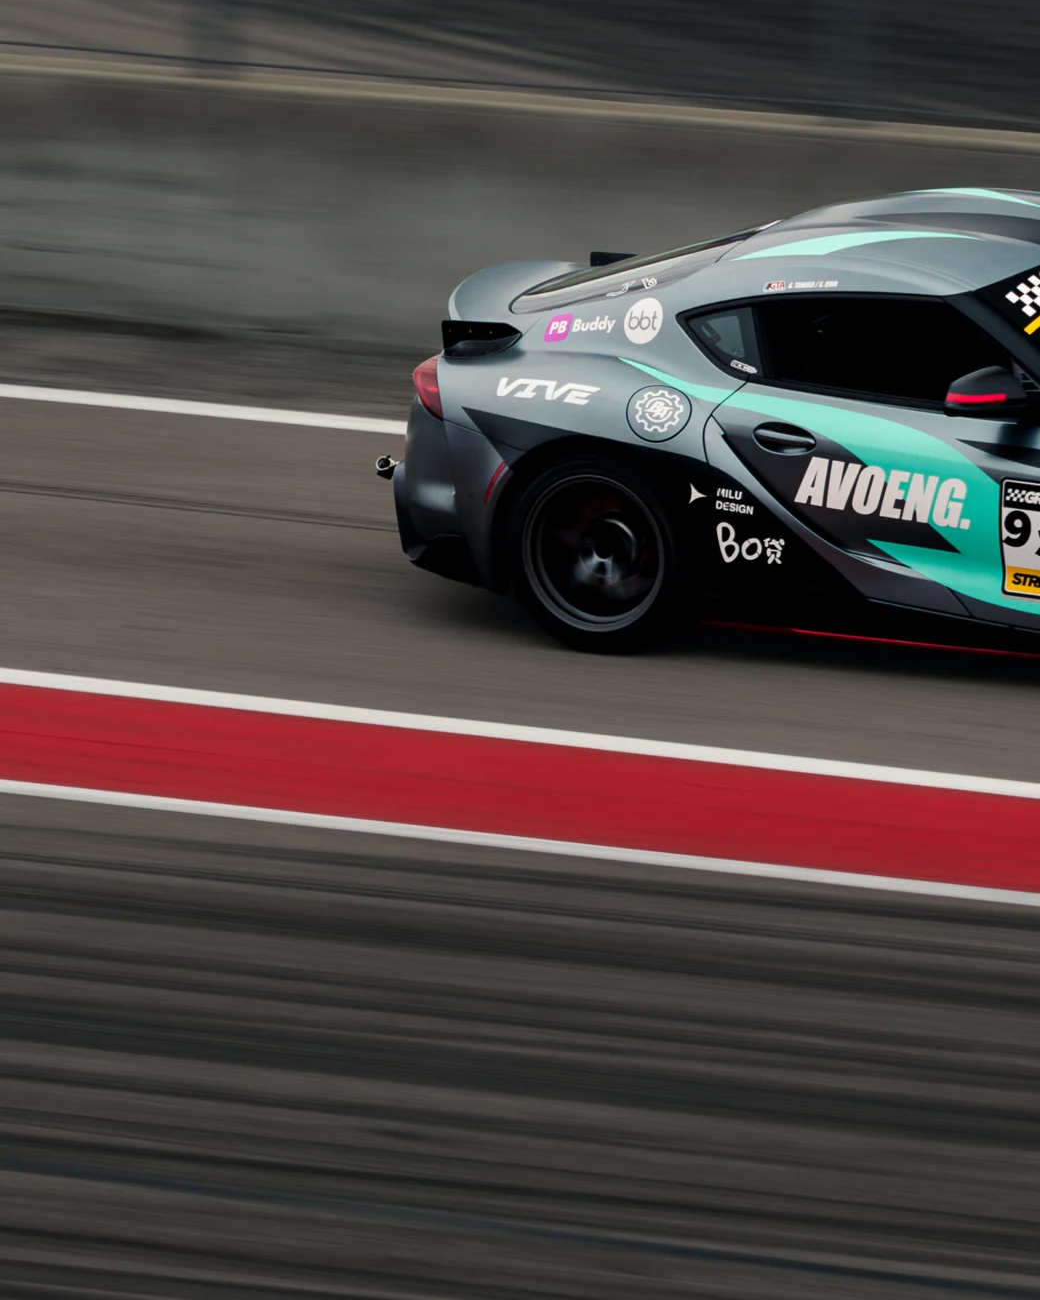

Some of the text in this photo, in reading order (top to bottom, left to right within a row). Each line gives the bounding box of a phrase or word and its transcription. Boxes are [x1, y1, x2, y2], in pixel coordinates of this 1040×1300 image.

[548, 315, 616, 335] PB Buddy
[628, 310, 658, 331] bbt
[496, 377, 601, 406] VIVE
[716, 487, 743, 501] MILU
[794, 456, 971, 530] AVOENG.
[715, 500, 754, 516] DESIGN
